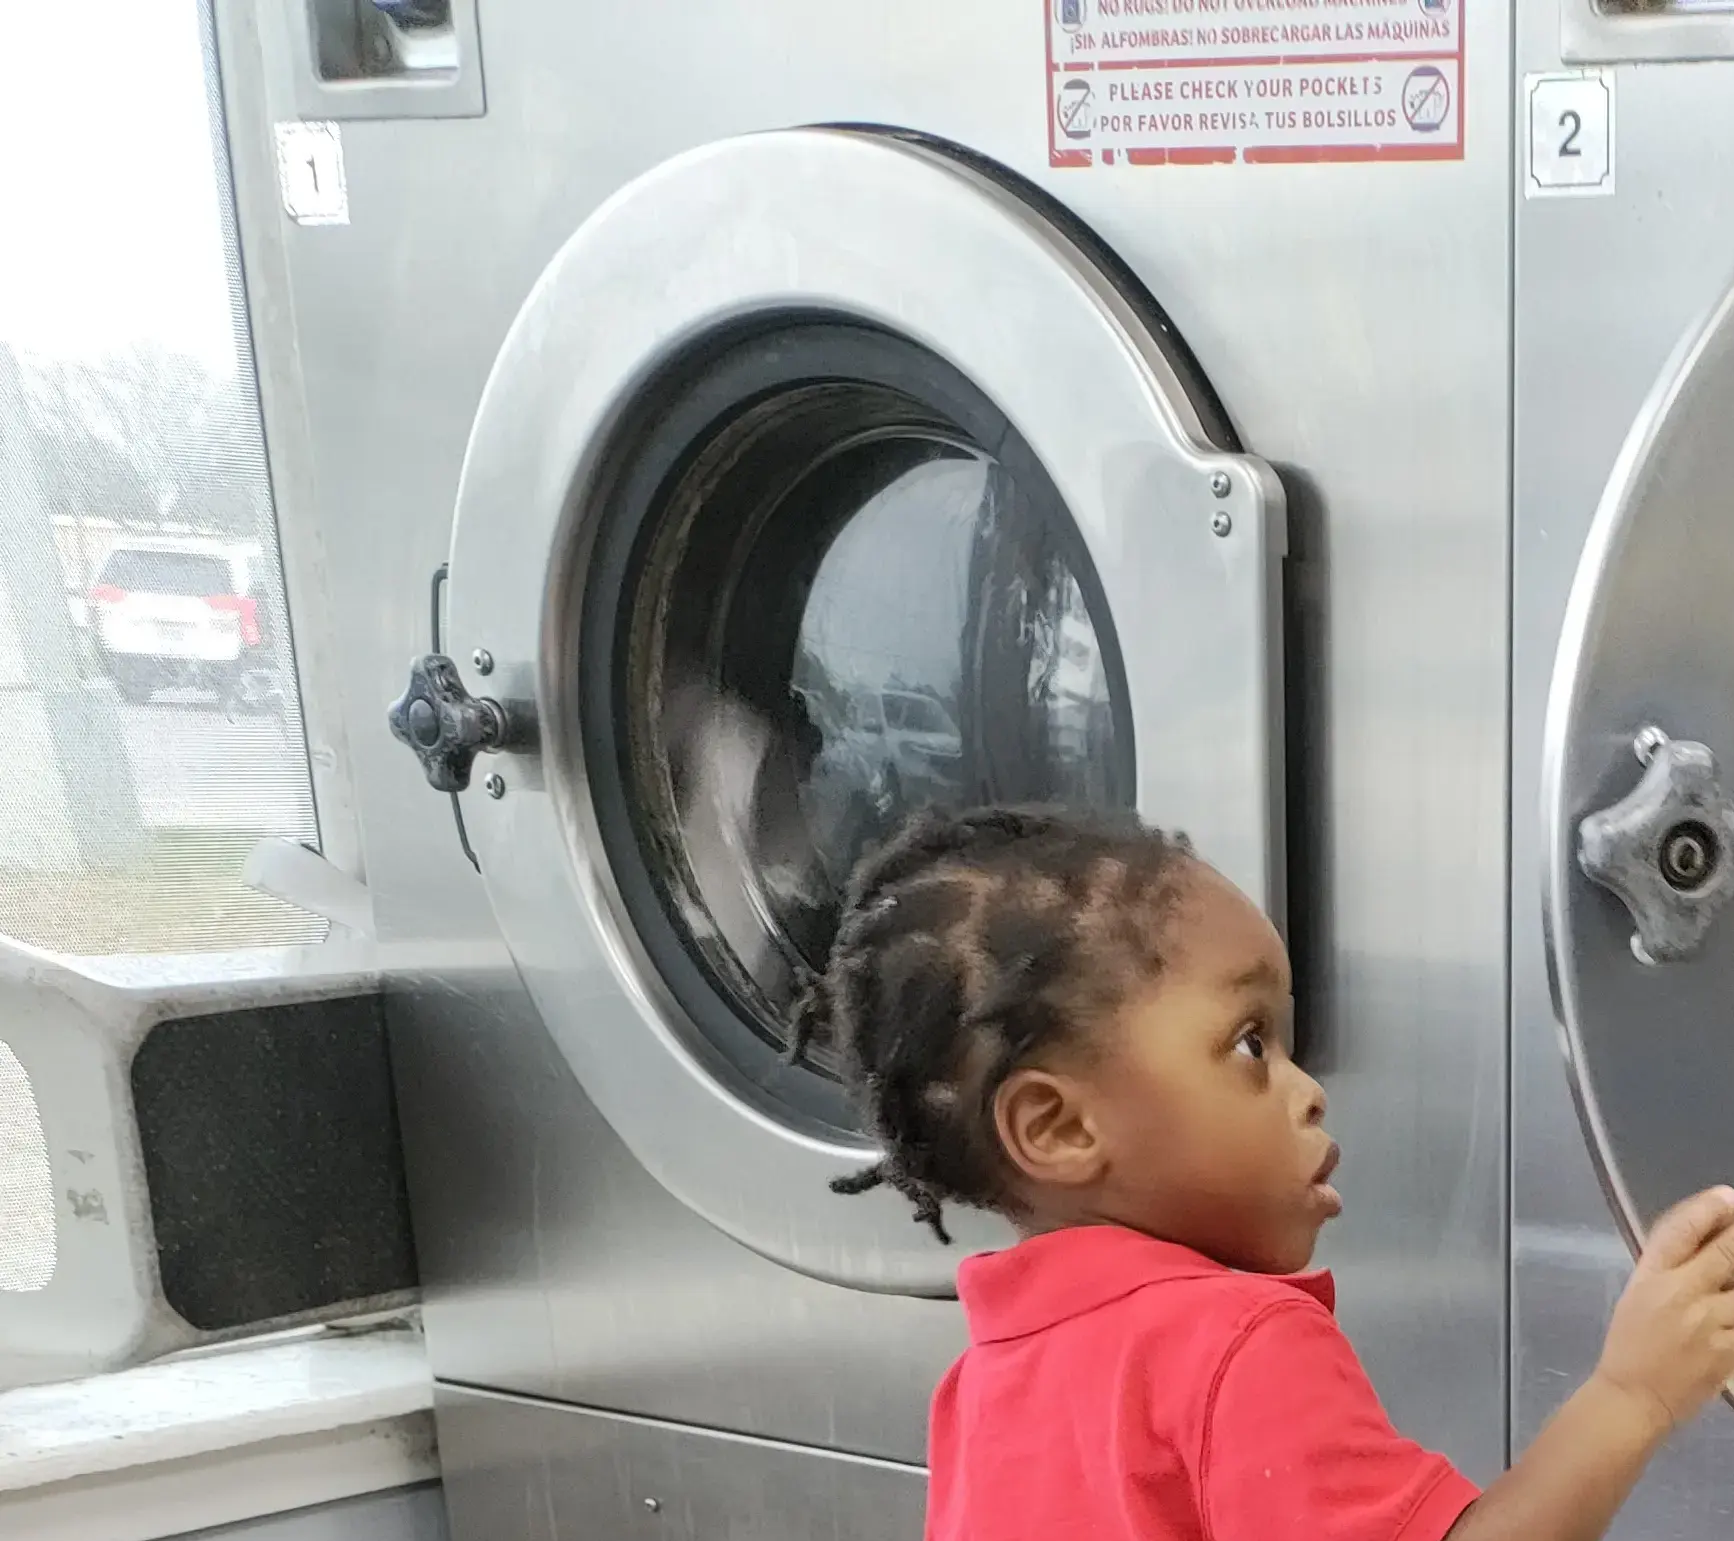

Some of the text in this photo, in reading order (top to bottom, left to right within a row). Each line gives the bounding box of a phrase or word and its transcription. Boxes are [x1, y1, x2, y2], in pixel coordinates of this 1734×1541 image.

[1099, 0, 1120, 16] NO
[1101, 28, 1193, 49] ALFOMBRAS!
[1197, 28, 1216, 44] NO
[1221, 22, 1332, 44] SOBRECARGAR
[1335, 23, 1364, 41] LAS
[1109, 76, 1382, 101] PLEASE CHECK YOUR POCKETS
[1101, 108, 1396, 132] POR FAVOR REVISA TUS BOLSILLOS
[1558, 109, 1582, 157] 2
[306, 154, 319, 193] 1
